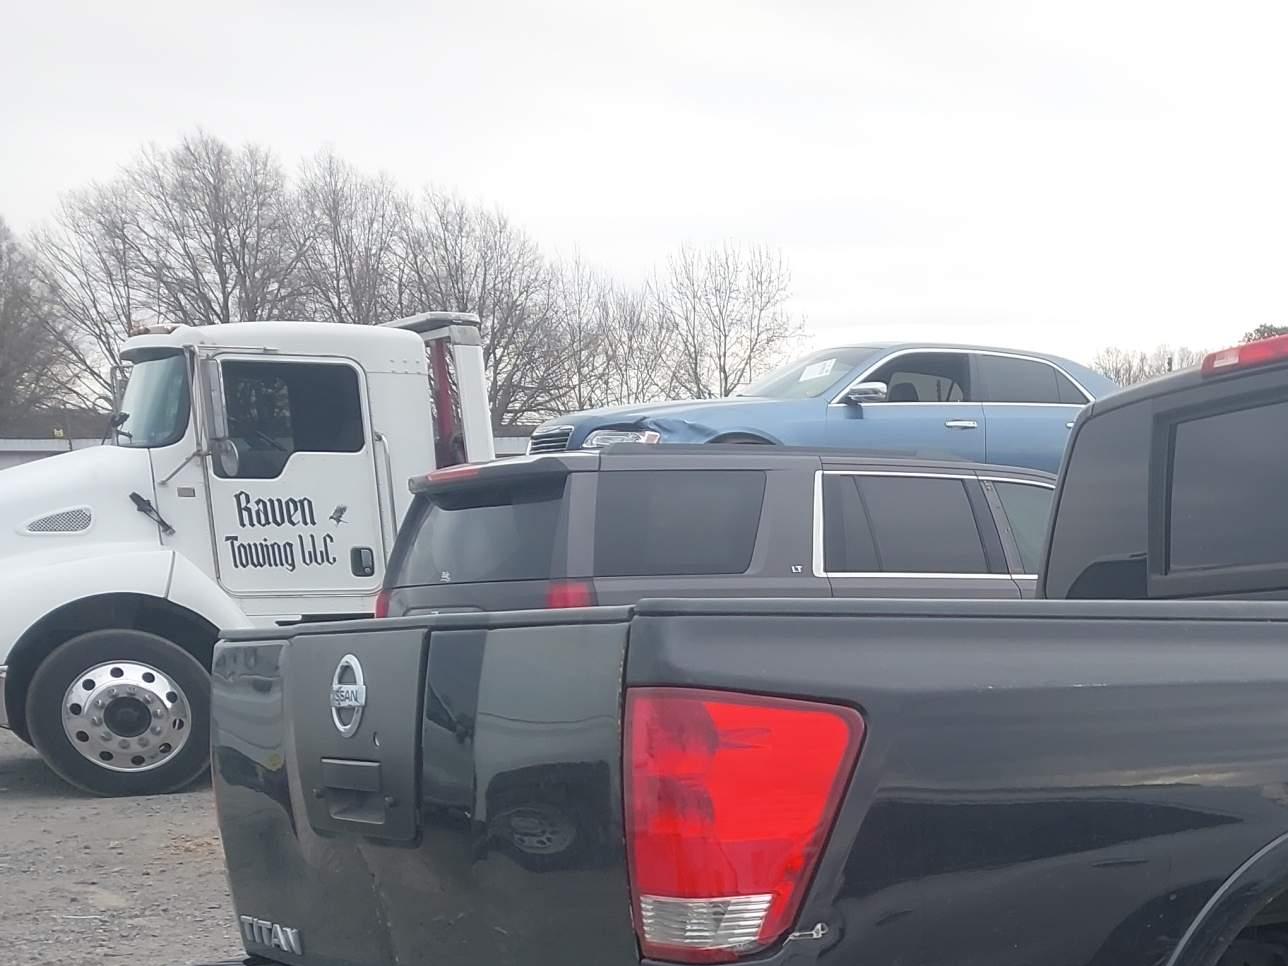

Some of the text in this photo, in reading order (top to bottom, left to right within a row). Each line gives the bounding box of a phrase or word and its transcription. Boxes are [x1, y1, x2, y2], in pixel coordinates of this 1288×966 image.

[233, 490, 317, 528] Raven
[224, 533, 337, 572] Towing LLC
[791, 565, 803, 573] LT
[240, 914, 303, 956] TITAN
